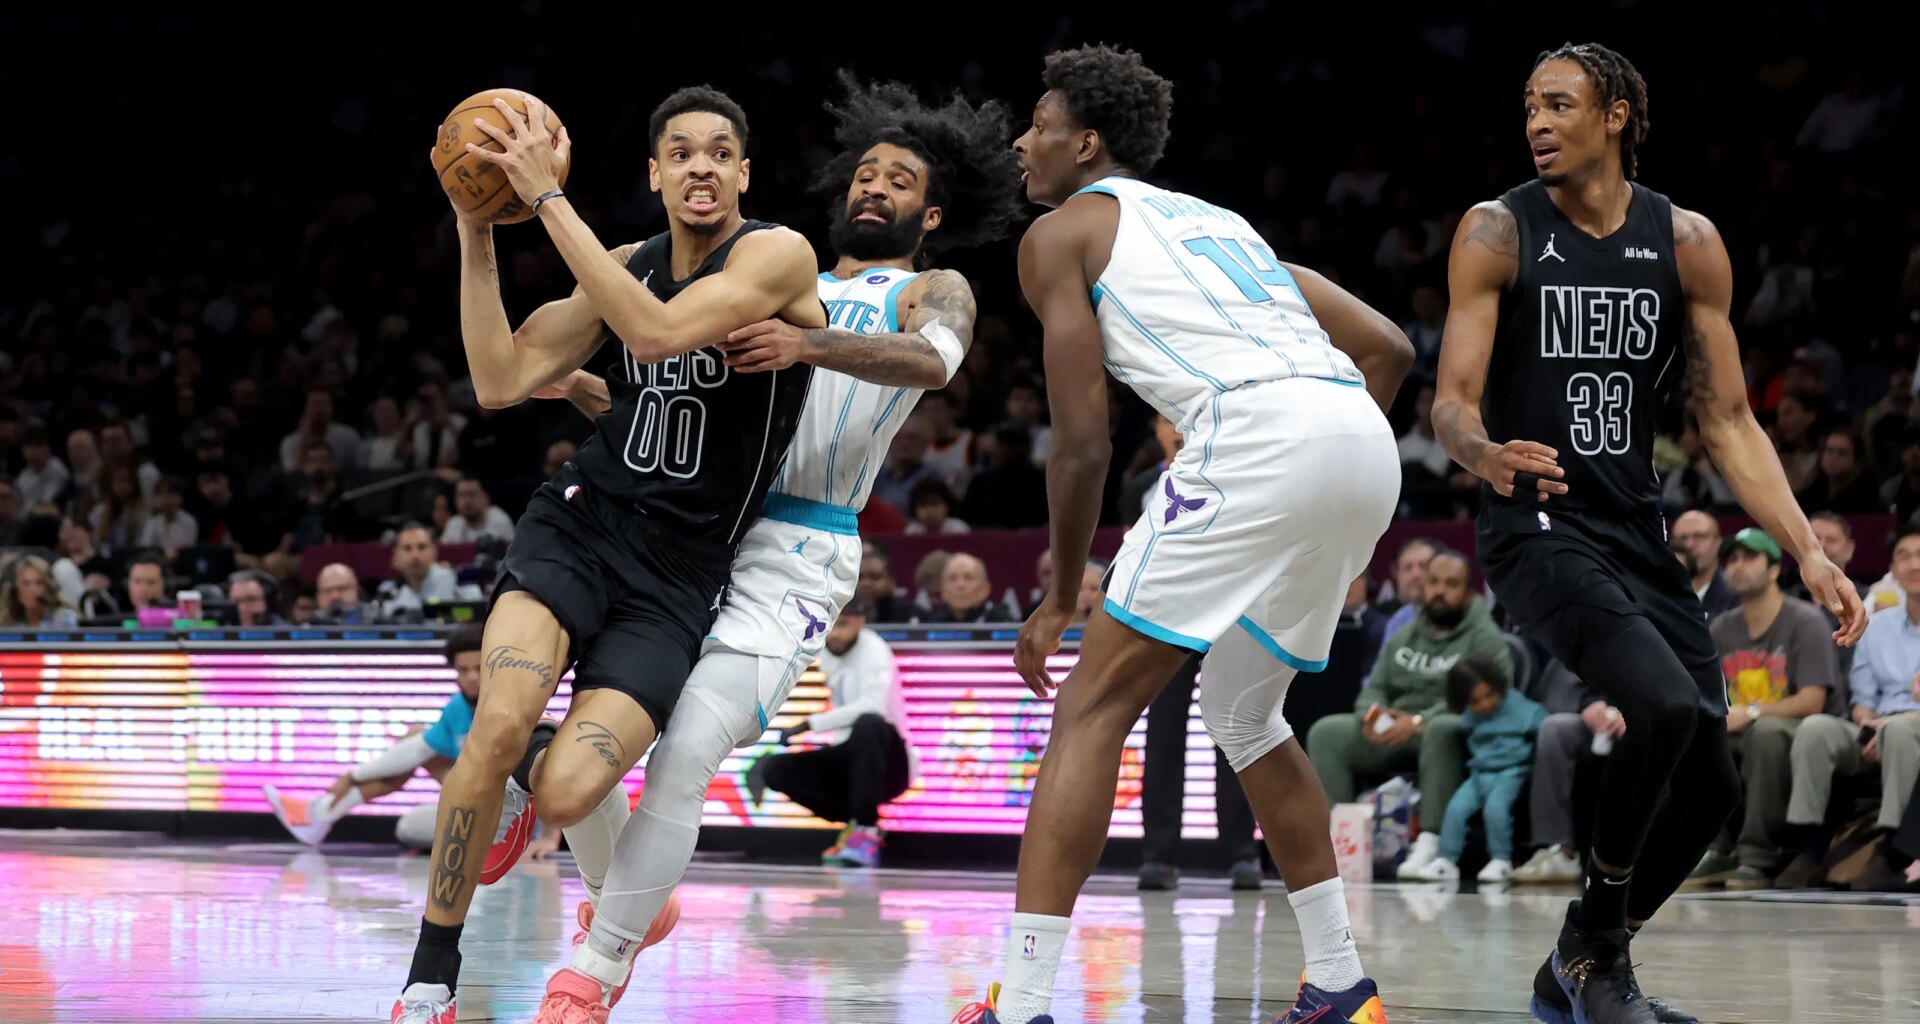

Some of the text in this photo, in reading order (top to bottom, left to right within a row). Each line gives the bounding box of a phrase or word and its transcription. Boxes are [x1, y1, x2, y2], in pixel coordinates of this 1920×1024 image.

[1181, 235, 1311, 317] 14
[1625, 247, 1635, 258] All
[1643, 248, 1658, 260] Won
[1540, 285, 1660, 360] NETS
[623, 386, 707, 479] 00
[1566, 372, 1634, 456] 33
[486, 645, 553, 688] Family
[575, 720, 626, 768] Ties
[435, 808, 474, 904] NOW
